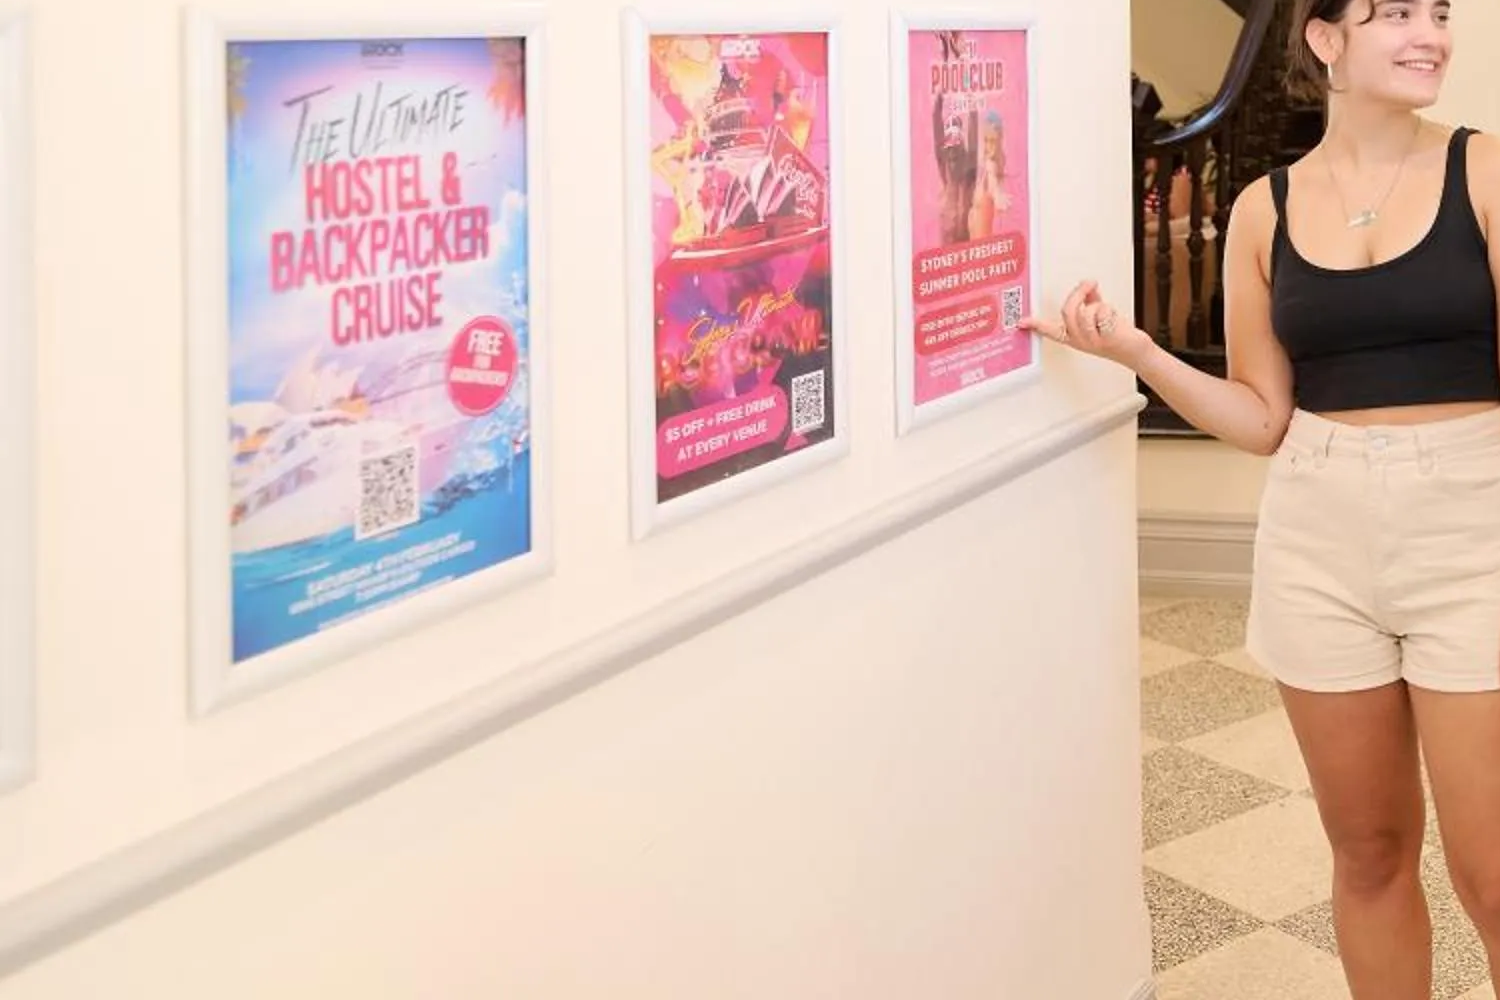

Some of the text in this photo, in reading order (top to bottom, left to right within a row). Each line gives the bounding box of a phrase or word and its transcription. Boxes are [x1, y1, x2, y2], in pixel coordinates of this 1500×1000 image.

[931, 61, 1003, 94] POOL CLUB
[283, 80, 469, 181] THE ULTIMATE
[305, 151, 461, 222] HOSTEL &
[270, 205, 489, 293] BACKPACKER
[969, 239, 1014, 261] FRESHEST
[919, 258, 1018, 296] SUMMER POOL PARTY
[331, 272, 443, 346] CRUISE
[467, 328, 505, 357] FREE
[682, 418, 705, 437] OFF
[715, 407, 744, 426] FREE
[745, 395, 777, 417] DRINK
[677, 419, 769, 462] AT EVERY VENUE
